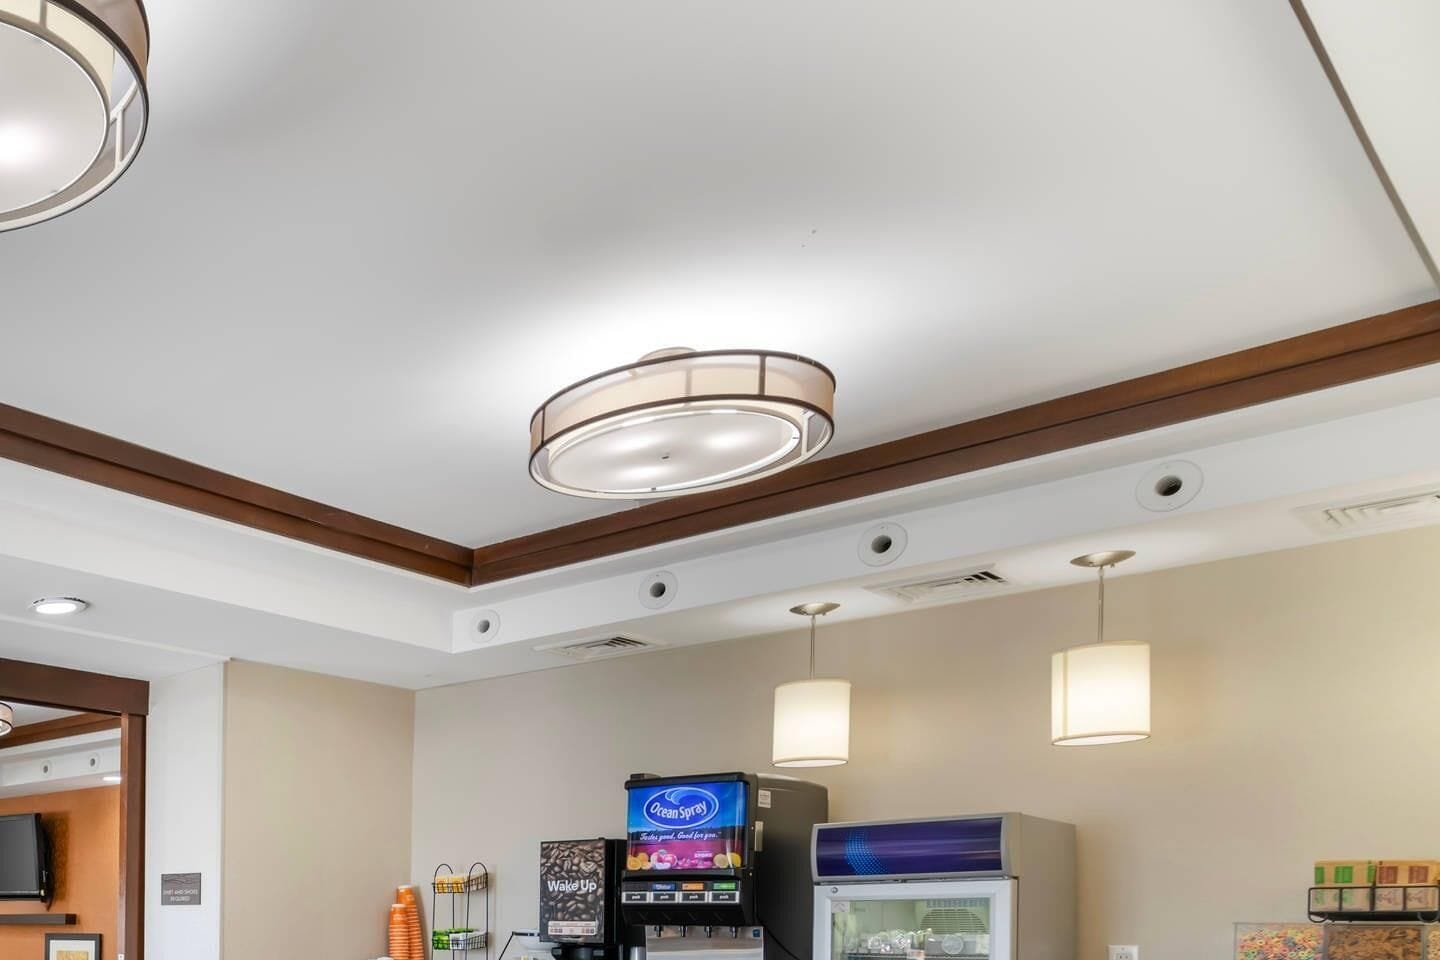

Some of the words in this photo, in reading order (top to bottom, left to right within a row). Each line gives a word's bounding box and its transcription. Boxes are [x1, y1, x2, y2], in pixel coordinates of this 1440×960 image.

[650, 802, 679, 819] Ocean
[679, 801, 707, 821] Spray
[677, 831, 694, 840] Good
[694, 831, 704, 840] for
[547, 880, 578, 892] Wake
[580, 879, 597, 893] Up
